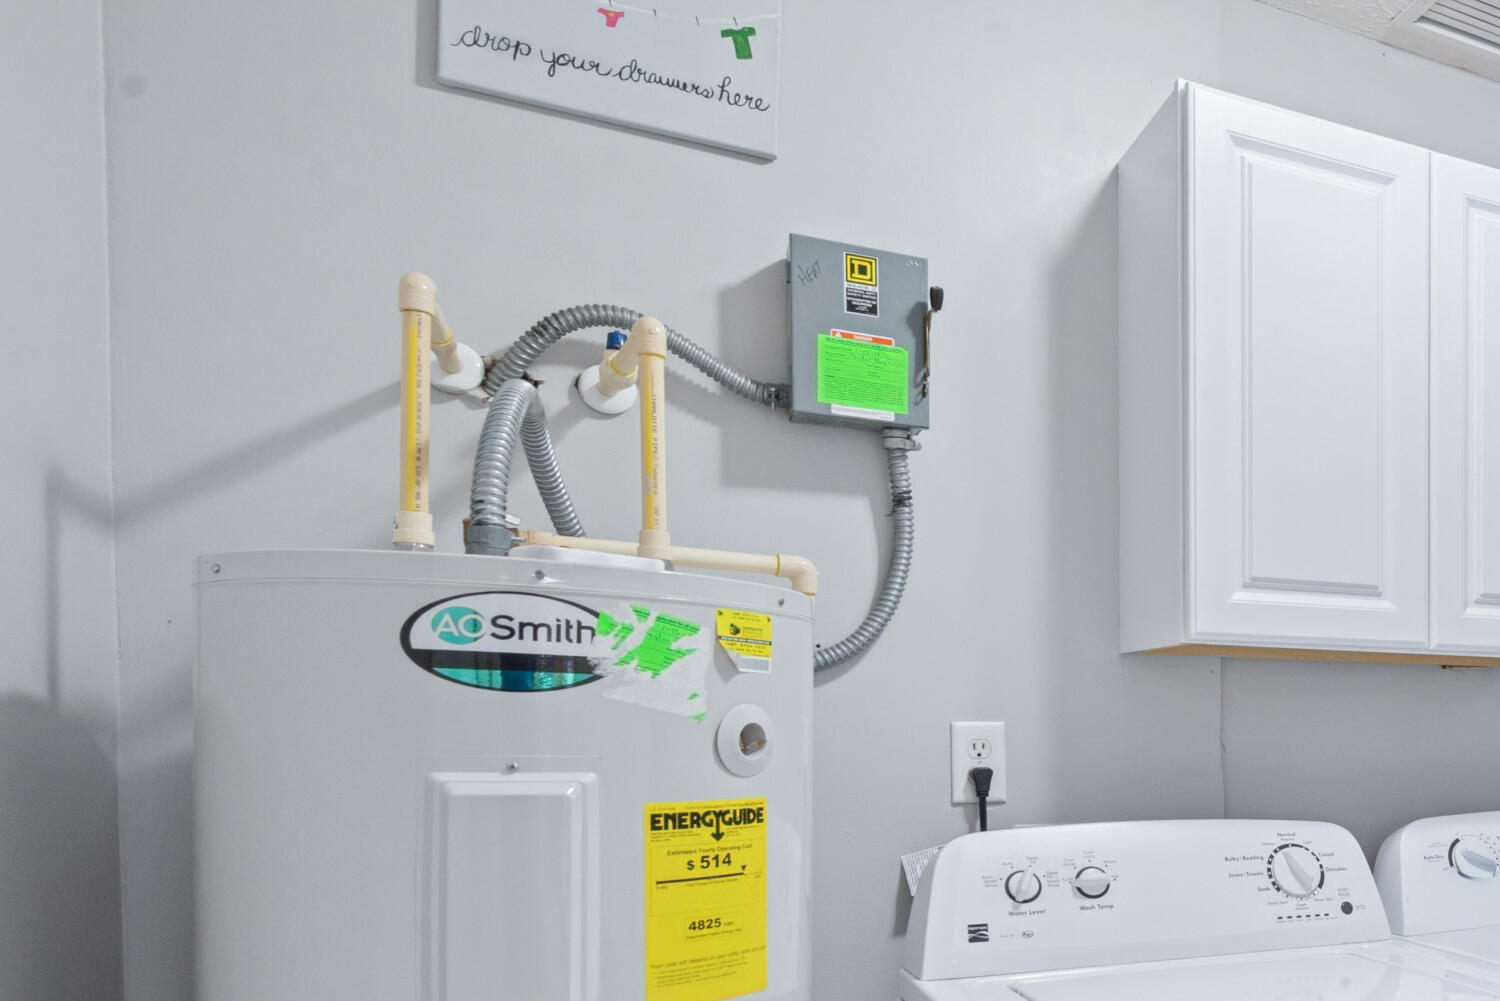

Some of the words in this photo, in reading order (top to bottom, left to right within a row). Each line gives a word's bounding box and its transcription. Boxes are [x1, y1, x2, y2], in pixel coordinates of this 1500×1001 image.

[451, 26, 531, 61] drop
[540, 48, 615, 78] your
[611, 59, 714, 99] drawers
[717, 76, 770, 112] here
[491, 613, 597, 645] Smith
[687, 860, 695, 871] $
[700, 853, 732, 869] 514
[688, 918, 722, 931] 4825
